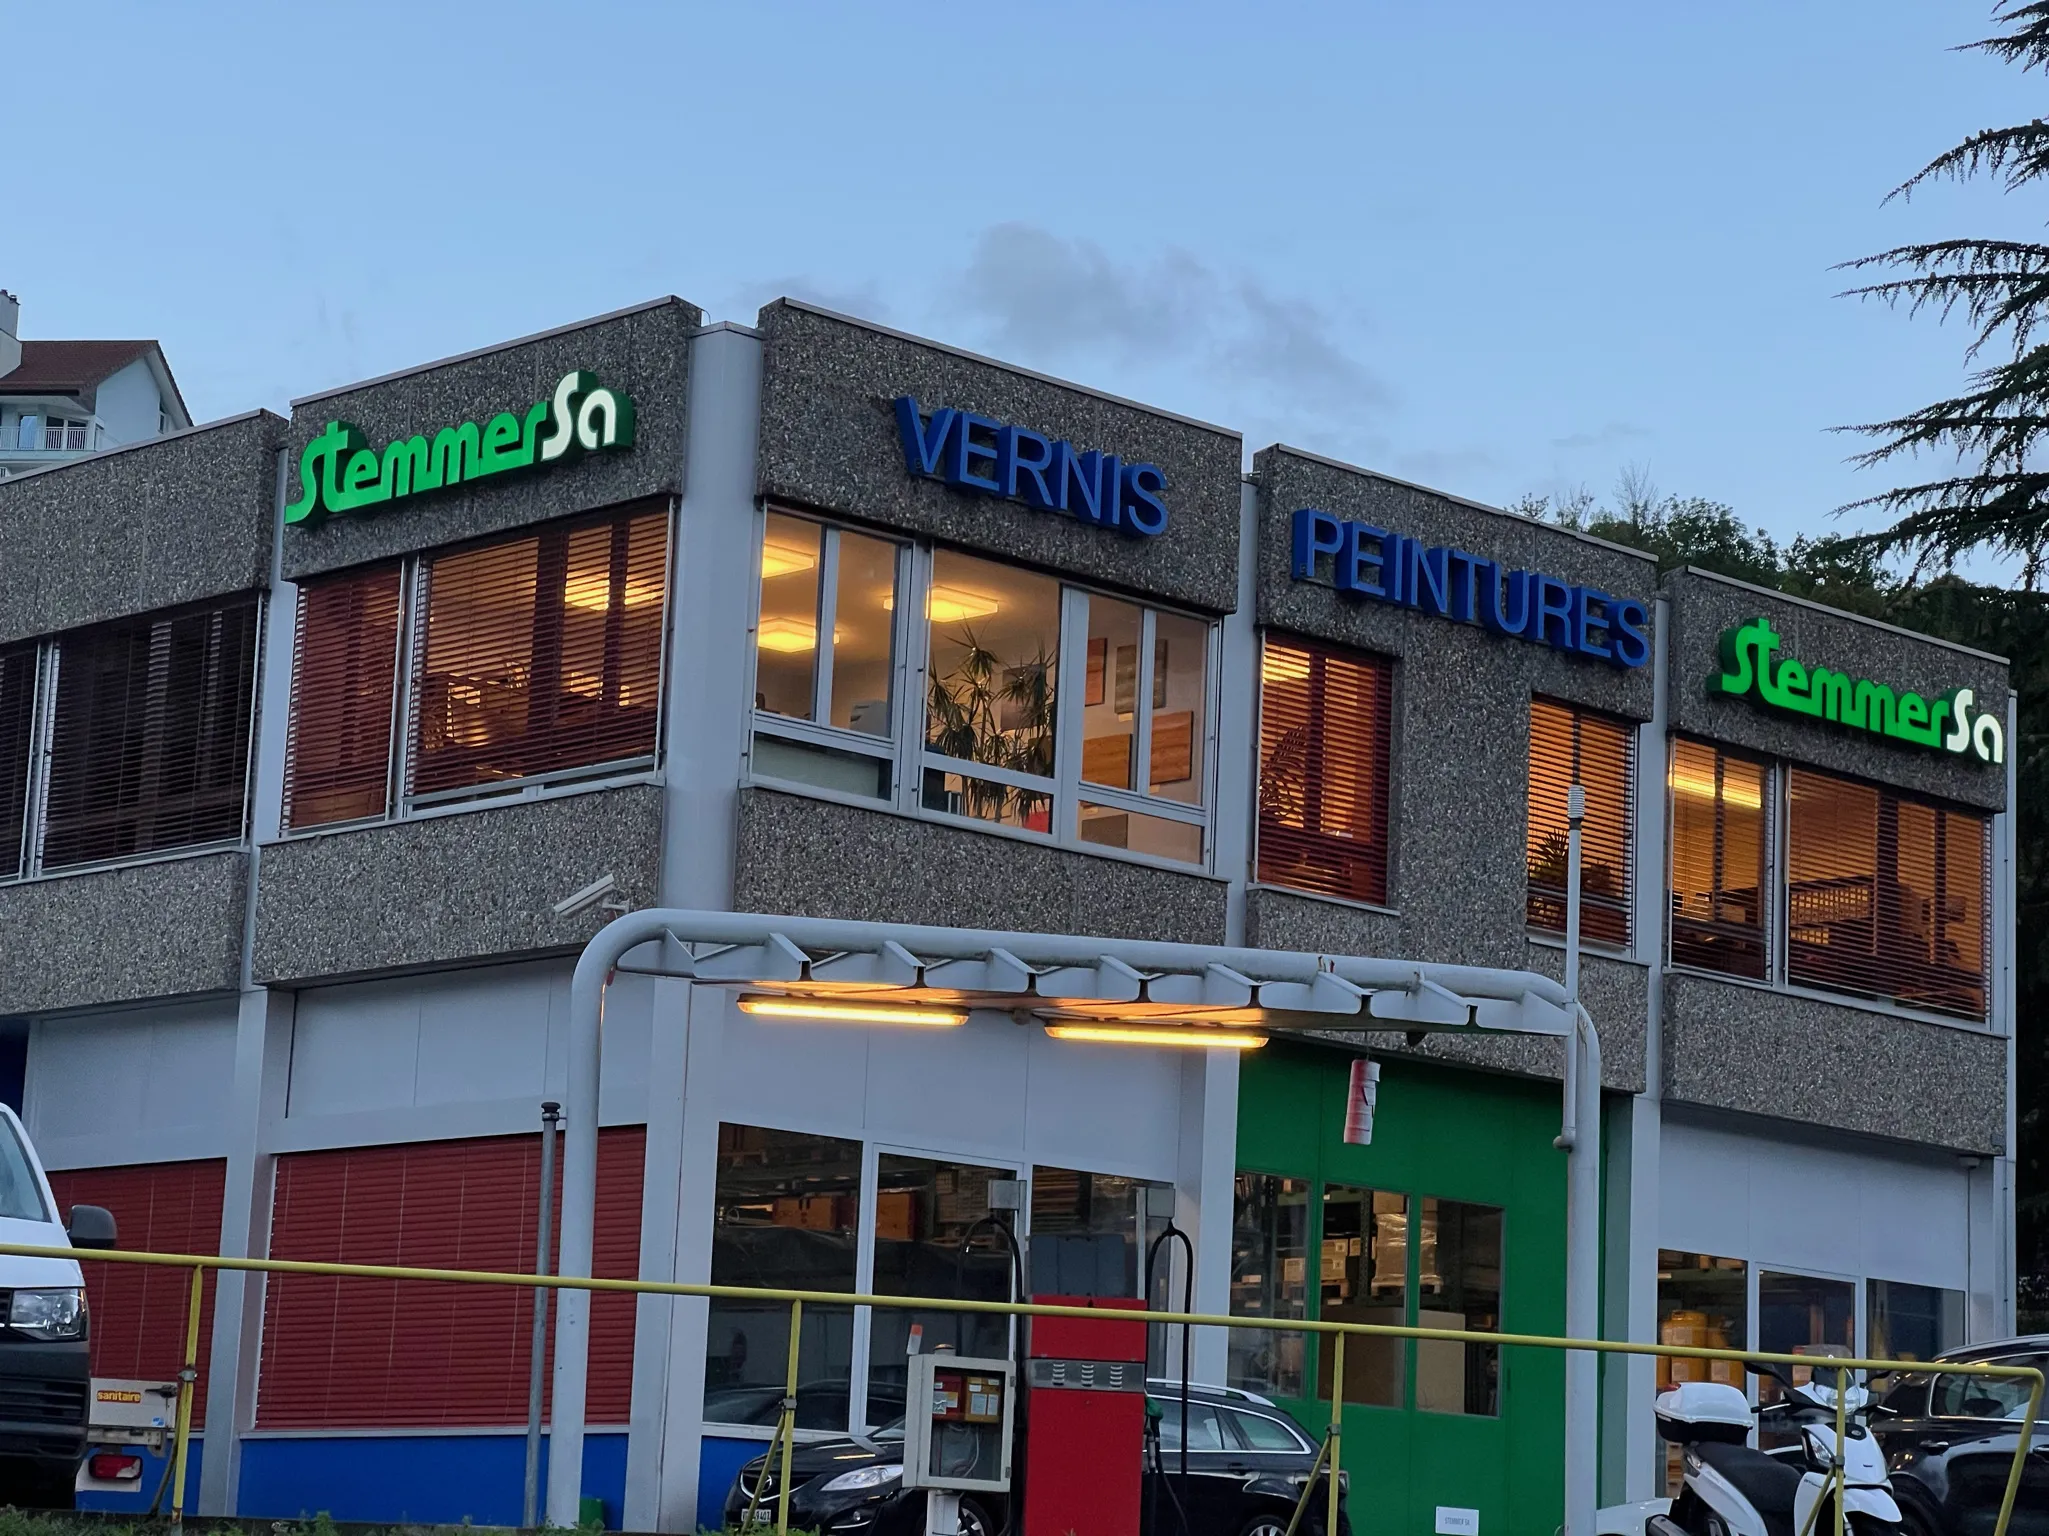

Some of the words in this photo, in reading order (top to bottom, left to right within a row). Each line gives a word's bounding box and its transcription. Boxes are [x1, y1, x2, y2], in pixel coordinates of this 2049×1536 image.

[895, 396, 1169, 536] VERNIS
[1292, 508, 1651, 667] PEINTURES
[97, 1390, 141, 1402] sanitaire
